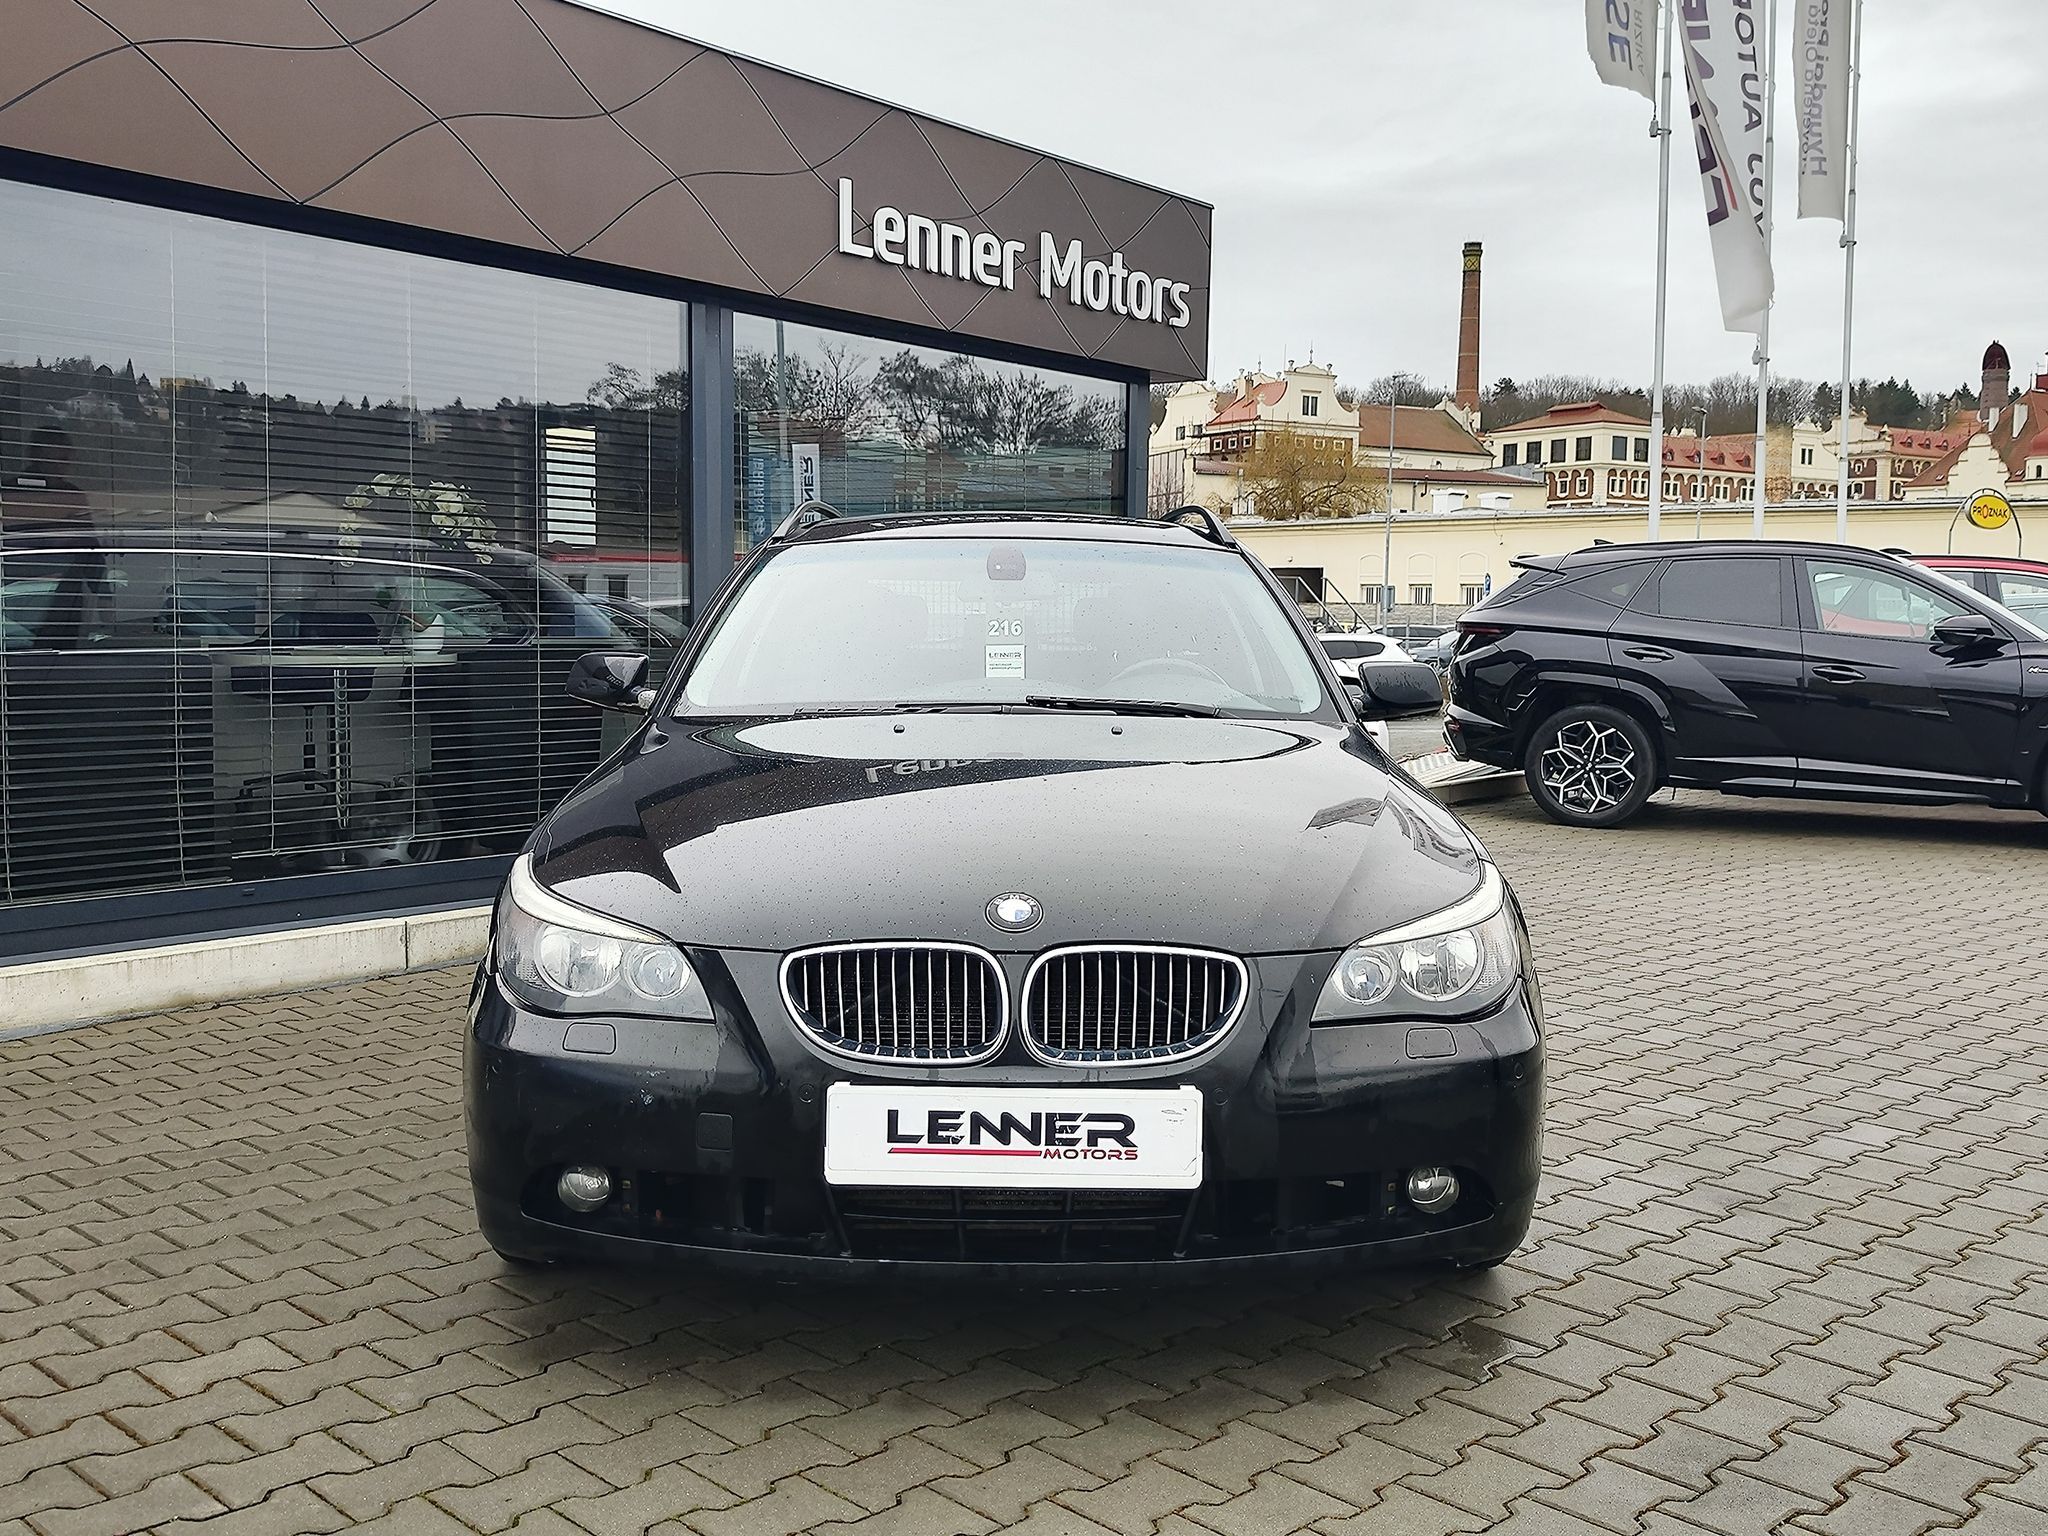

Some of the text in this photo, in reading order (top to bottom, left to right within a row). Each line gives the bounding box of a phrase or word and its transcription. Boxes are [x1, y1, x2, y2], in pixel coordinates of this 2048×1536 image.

[838, 176, 1192, 329] Lenner Motors
[988, 620, 1022, 636] 216
[886, 1109, 1139, 1148] LENNER
[1042, 1148, 1139, 1161] MOTORS
